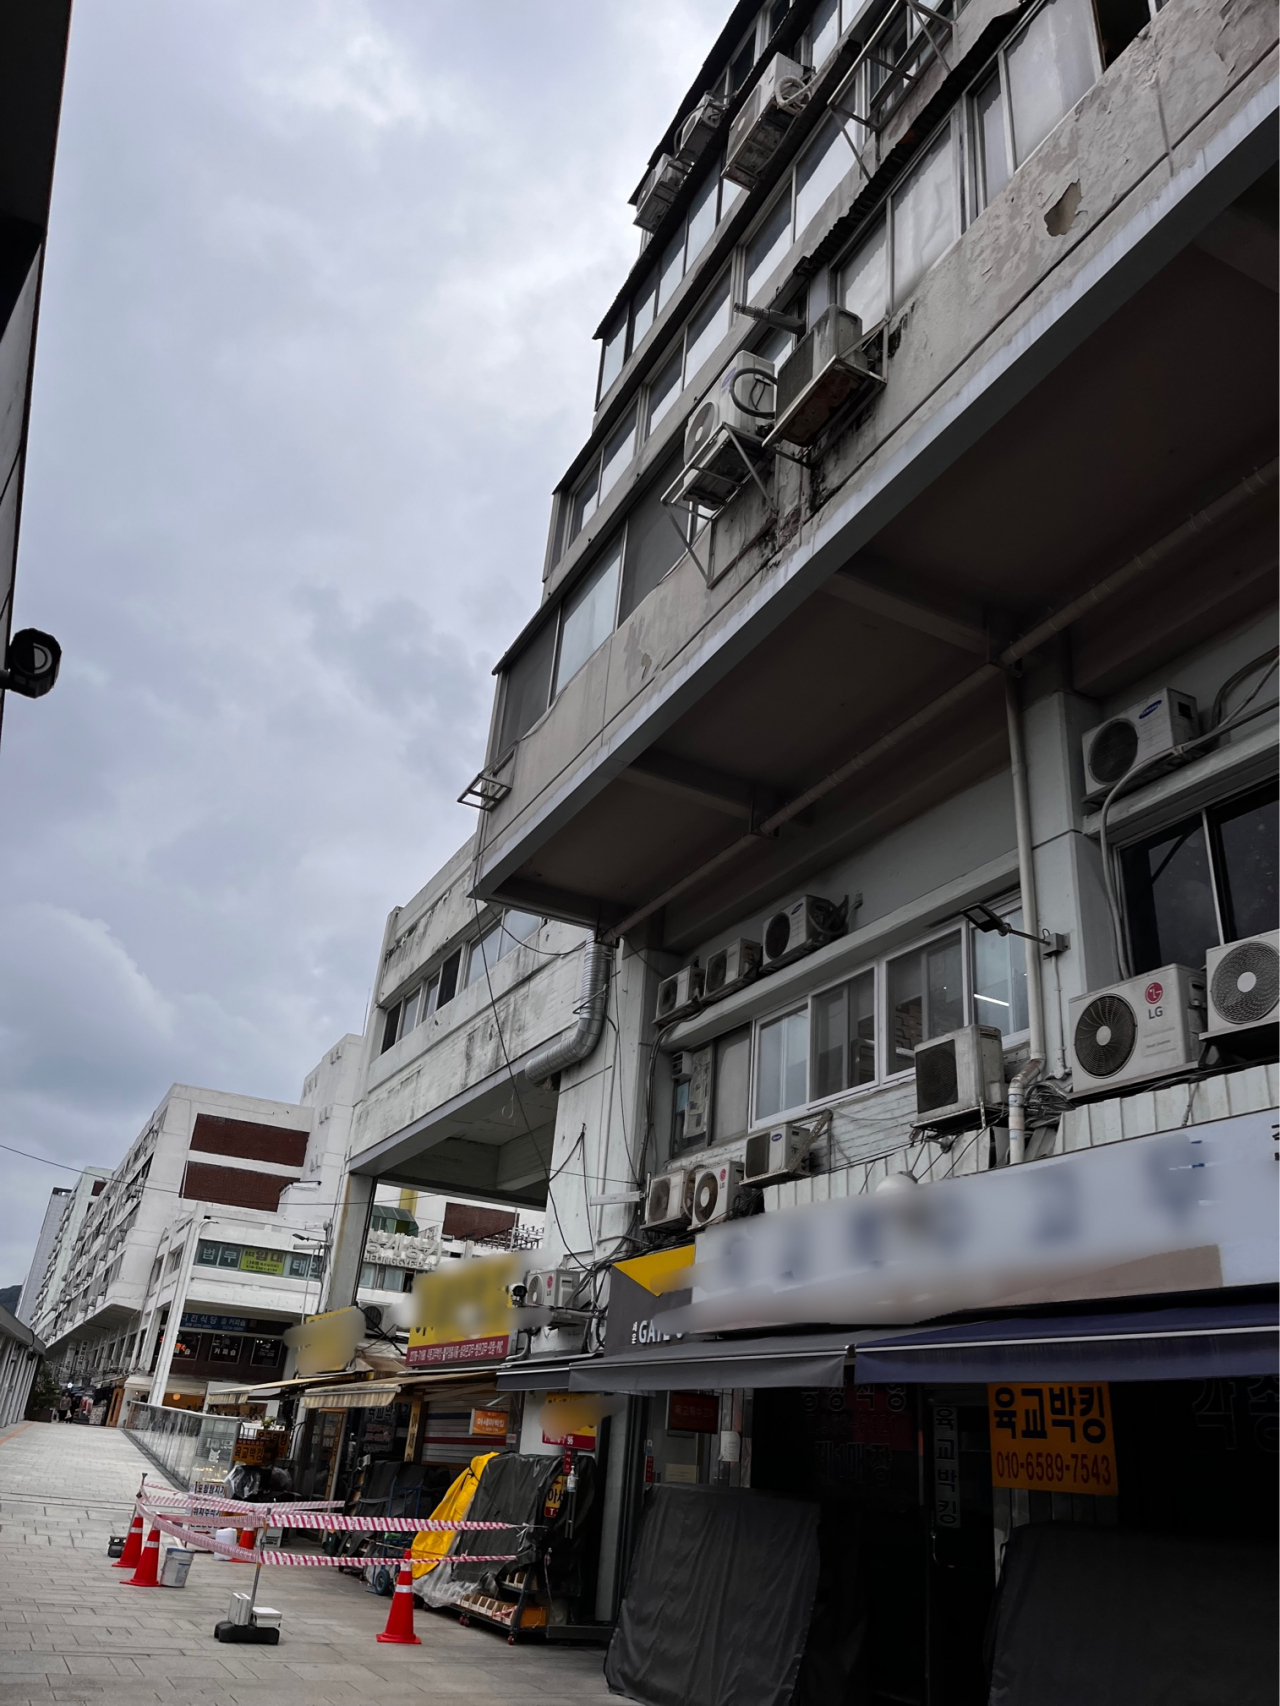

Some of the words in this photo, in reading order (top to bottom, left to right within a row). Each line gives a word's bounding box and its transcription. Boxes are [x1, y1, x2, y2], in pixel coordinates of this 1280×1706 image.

[1148, 1006, 1163, 1020] LG
[202, 1248, 237, 1263] 법무
[255, 1250, 283, 1263] 임대
[214, 1347, 237, 1356] 커피숍
[993, 1386, 1107, 1444] 육교박킹
[235, 1446, 264, 1461] 육교박킹
[936, 1407, 958, 1525] 육교박킹
[996, 1451, 1112, 1485] 010-6589-7543
